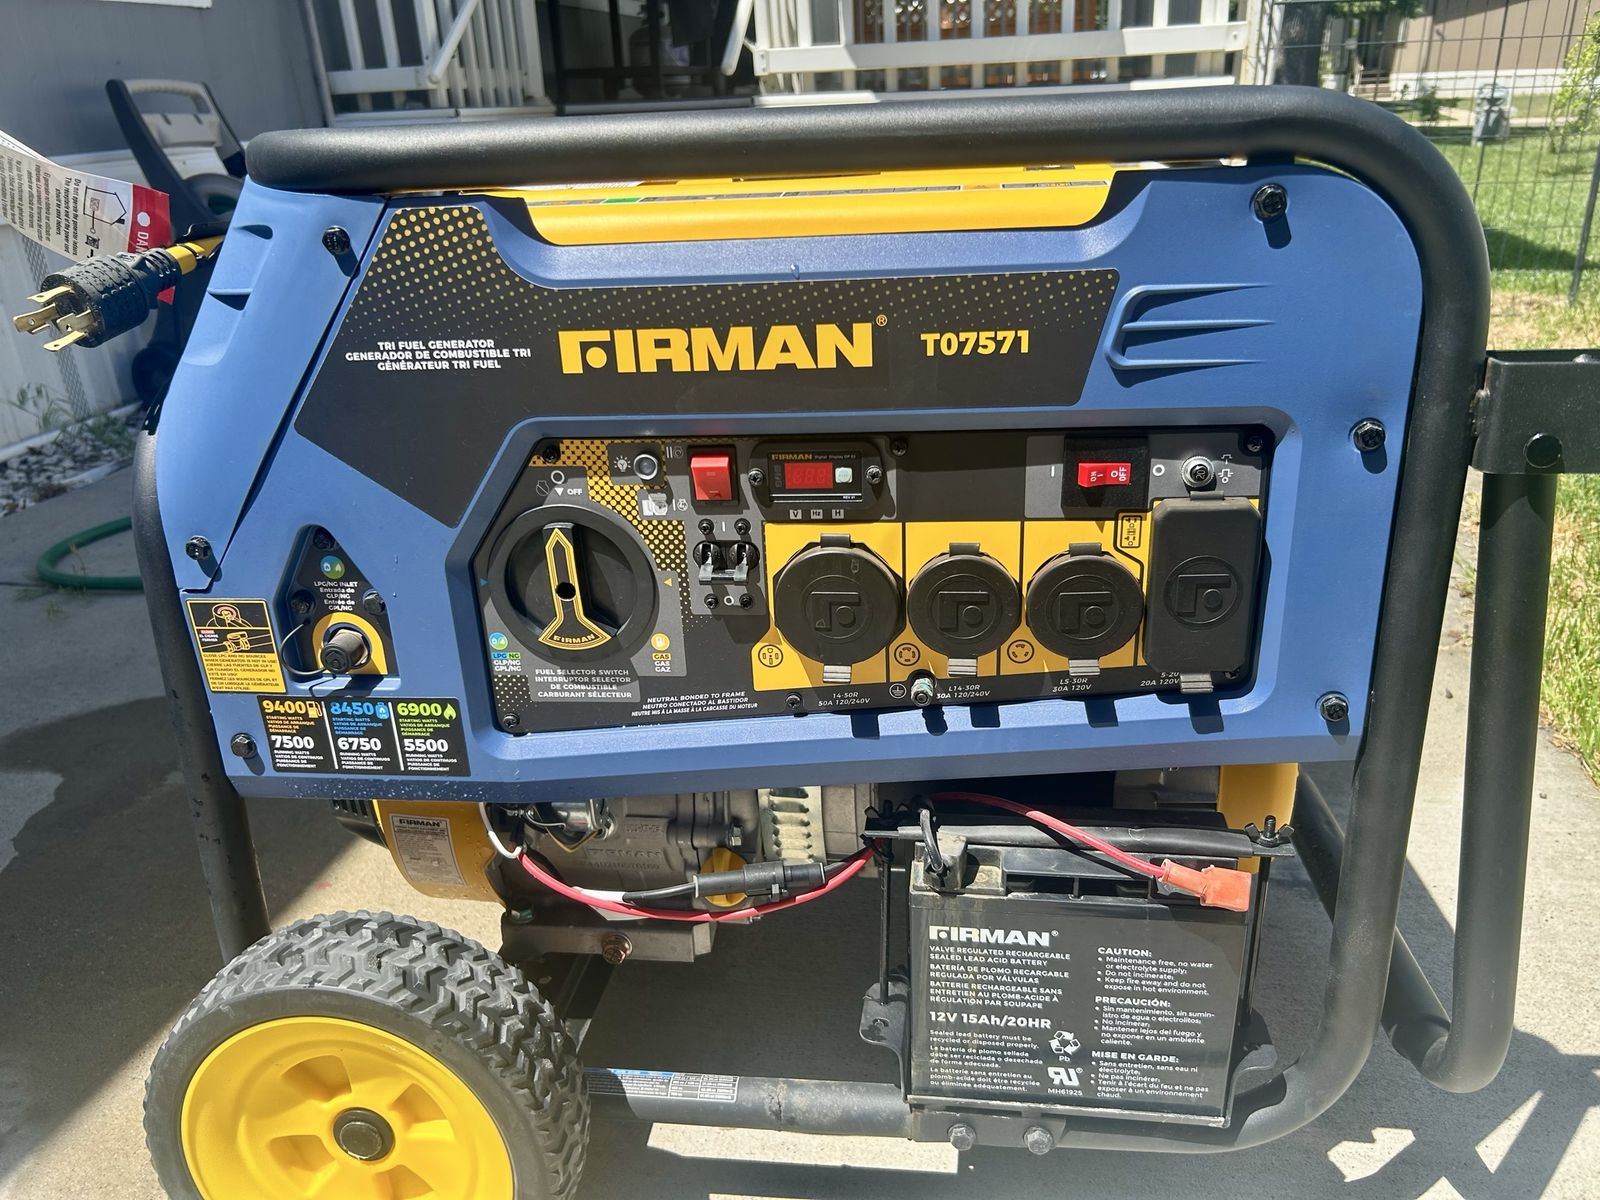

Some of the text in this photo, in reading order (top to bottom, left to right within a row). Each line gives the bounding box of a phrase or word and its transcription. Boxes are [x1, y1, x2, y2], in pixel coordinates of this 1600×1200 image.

[378, 339, 494, 350] TRI FUEL GENERATOR
[921, 330, 1030, 356] T07571
[346, 348, 531, 361] GENERADOR DE COMBUSTIBLE TRI
[378, 360, 500, 371] GÉNÉRATEUR TRI FUEL
[1196, 470, 1205, 479] 20
[553, 634, 596, 644] FIRMAN
[954, 690, 990, 698] 120/240V
[263, 700, 306, 714] 9400
[331, 702, 374, 715] 8450
[397, 703, 442, 716] 6900
[669, 700, 706, 708] CONECTADO
[271, 735, 314, 749] 7500
[338, 737, 381, 750] 6750
[404, 739, 448, 752] 5500
[957, 948, 1003, 957] REGULATED
[1006, 950, 1070, 960] RECHARGEABLE
[1098, 947, 1151, 958] CAUTION:
[930, 954, 960, 962] SEALED
[1010, 958, 1047, 967] BATTERY
[1106, 957, 1156, 965] Maintenance
[930, 964, 964, 972] BATERÍA
[980, 967, 1010, 975] PLOMO
[1013, 968, 1069, 978] RECARGABLE
[1133, 972, 1173, 981] incinerate;
[930, 972, 974, 980] REGULADA
[996, 975, 1039, 984] VÁLVULAS
[930, 981, 968, 990] BATTERIE
[971, 984, 1036, 993] RECHARGEABLE
[1158, 987, 1209, 996] environment.
[930, 989, 974, 998] ENTRETIEN
[992, 992, 1049, 1002] PLOMB-ACIDE
[930, 996, 981, 1006] RÉGULATION
[1004, 1000, 1042, 1009] SOUPAPE
[1095, 996, 1170, 1008] PRECAUCIÓN:
[930, 1012, 1051, 1029] 12V 15Ah/20HR
[1092, 1051, 1179, 1063] MISE EN GARDE:
